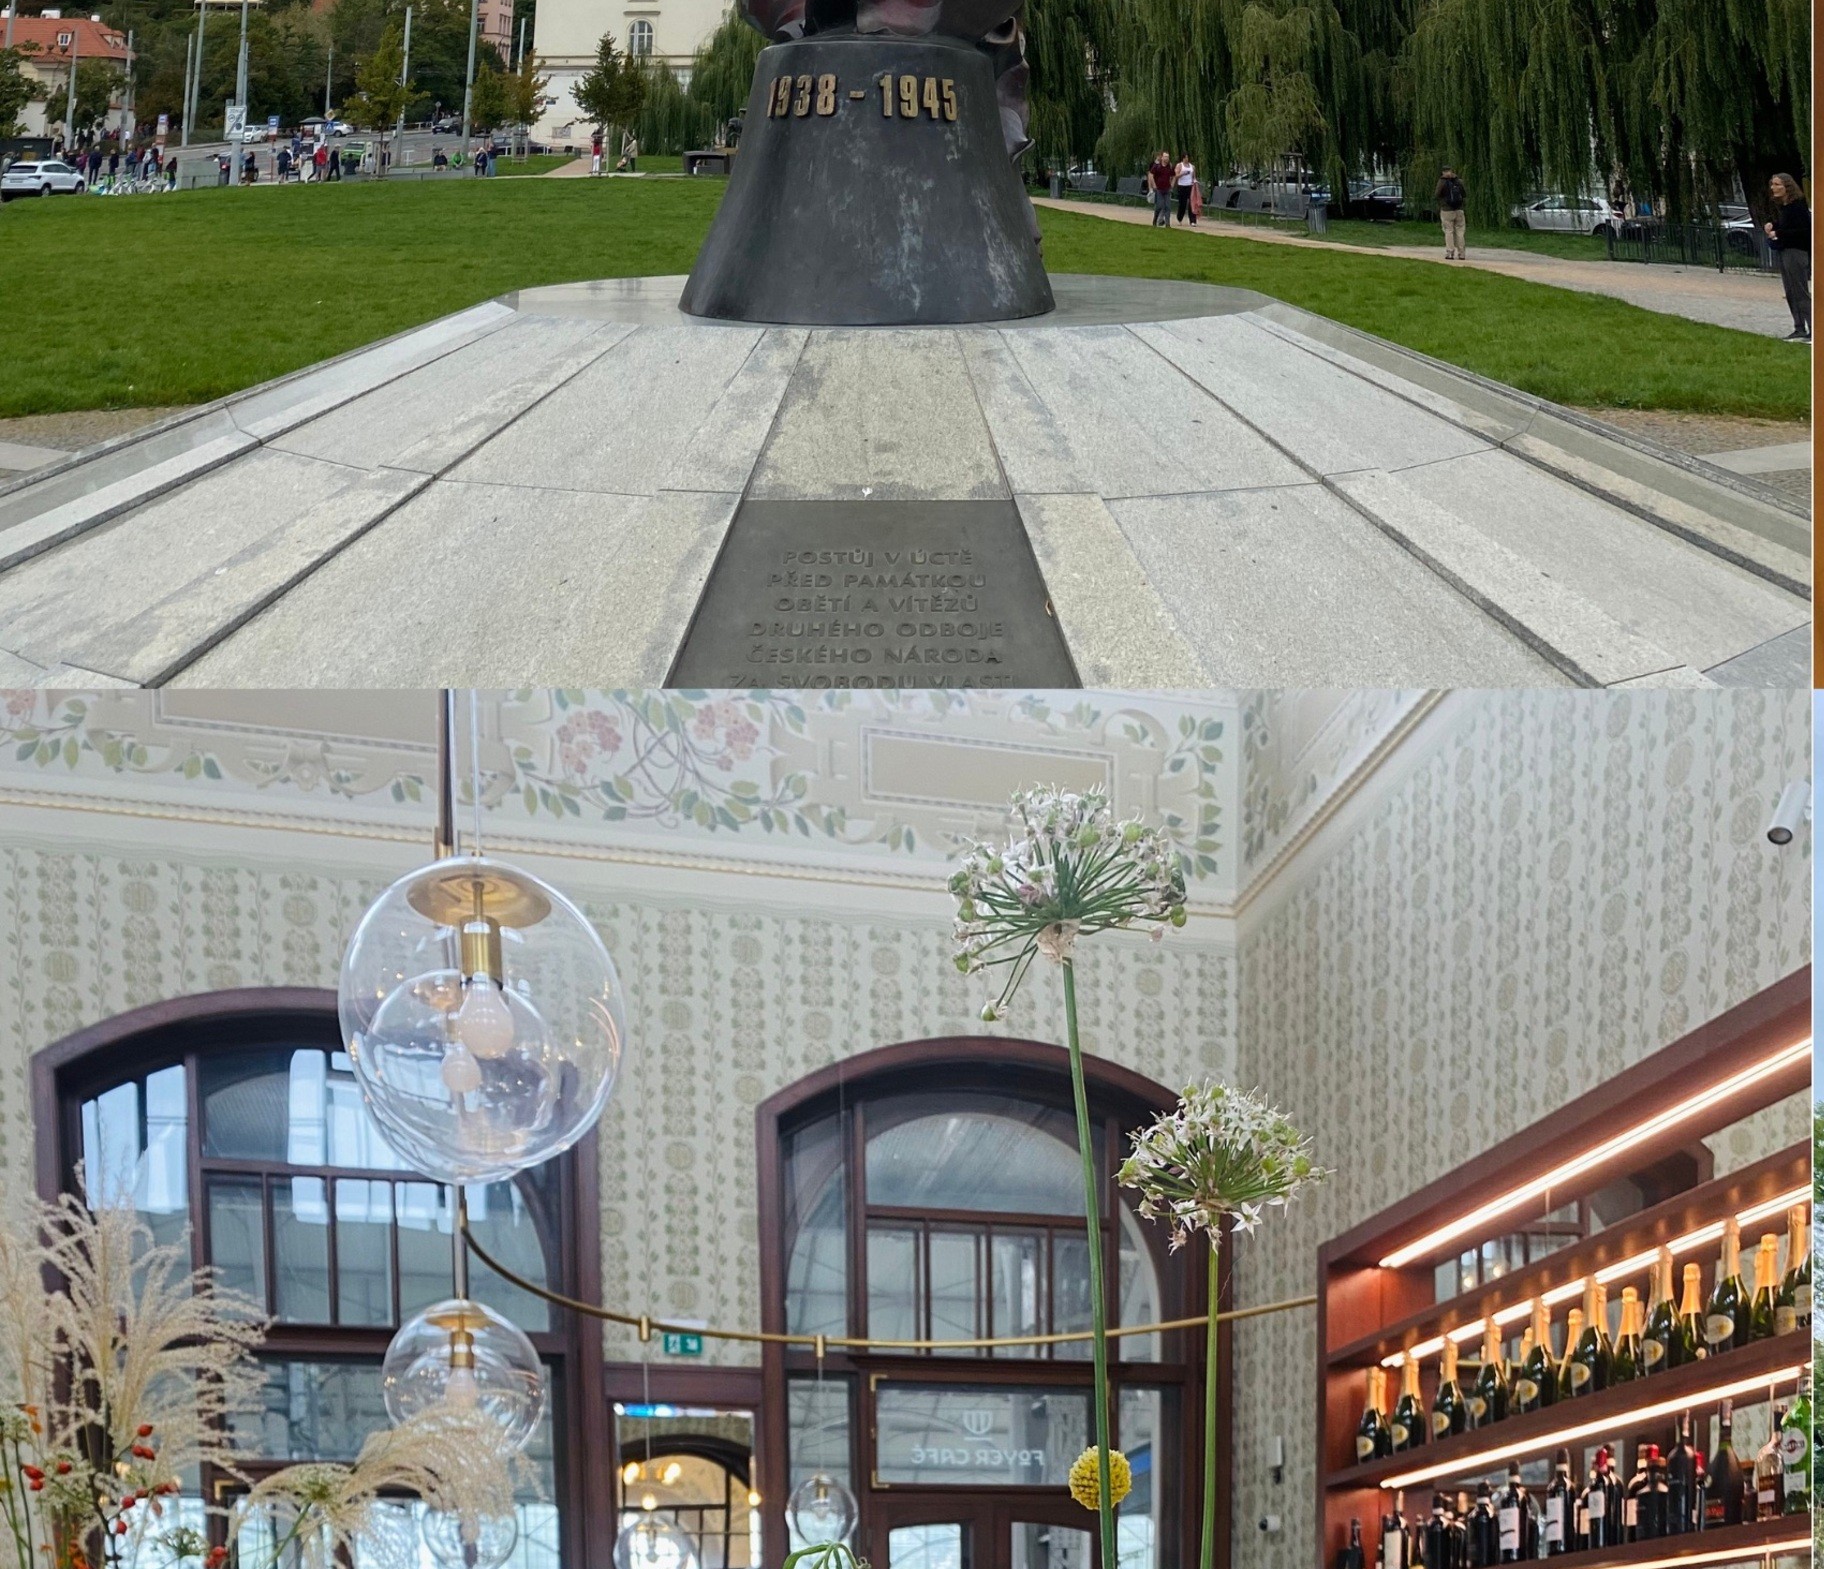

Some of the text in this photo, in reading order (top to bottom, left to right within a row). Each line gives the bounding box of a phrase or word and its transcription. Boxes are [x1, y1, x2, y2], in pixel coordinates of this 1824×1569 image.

[767, 73, 837, 119] 1938
[879, 74, 958, 122] 1945
[782, 548, 973, 568] POSTŮJ V ÚCTĚ
[767, 571, 987, 589] PŘED PAMÁTKOU
[774, 594, 979, 613] OBĚTÍ A VÍTĚZŮ
[749, 620, 1003, 640] DRUHÉHO ODBOJE
[746, 645, 1003, 664] ČESKÉHO NÁRODA
